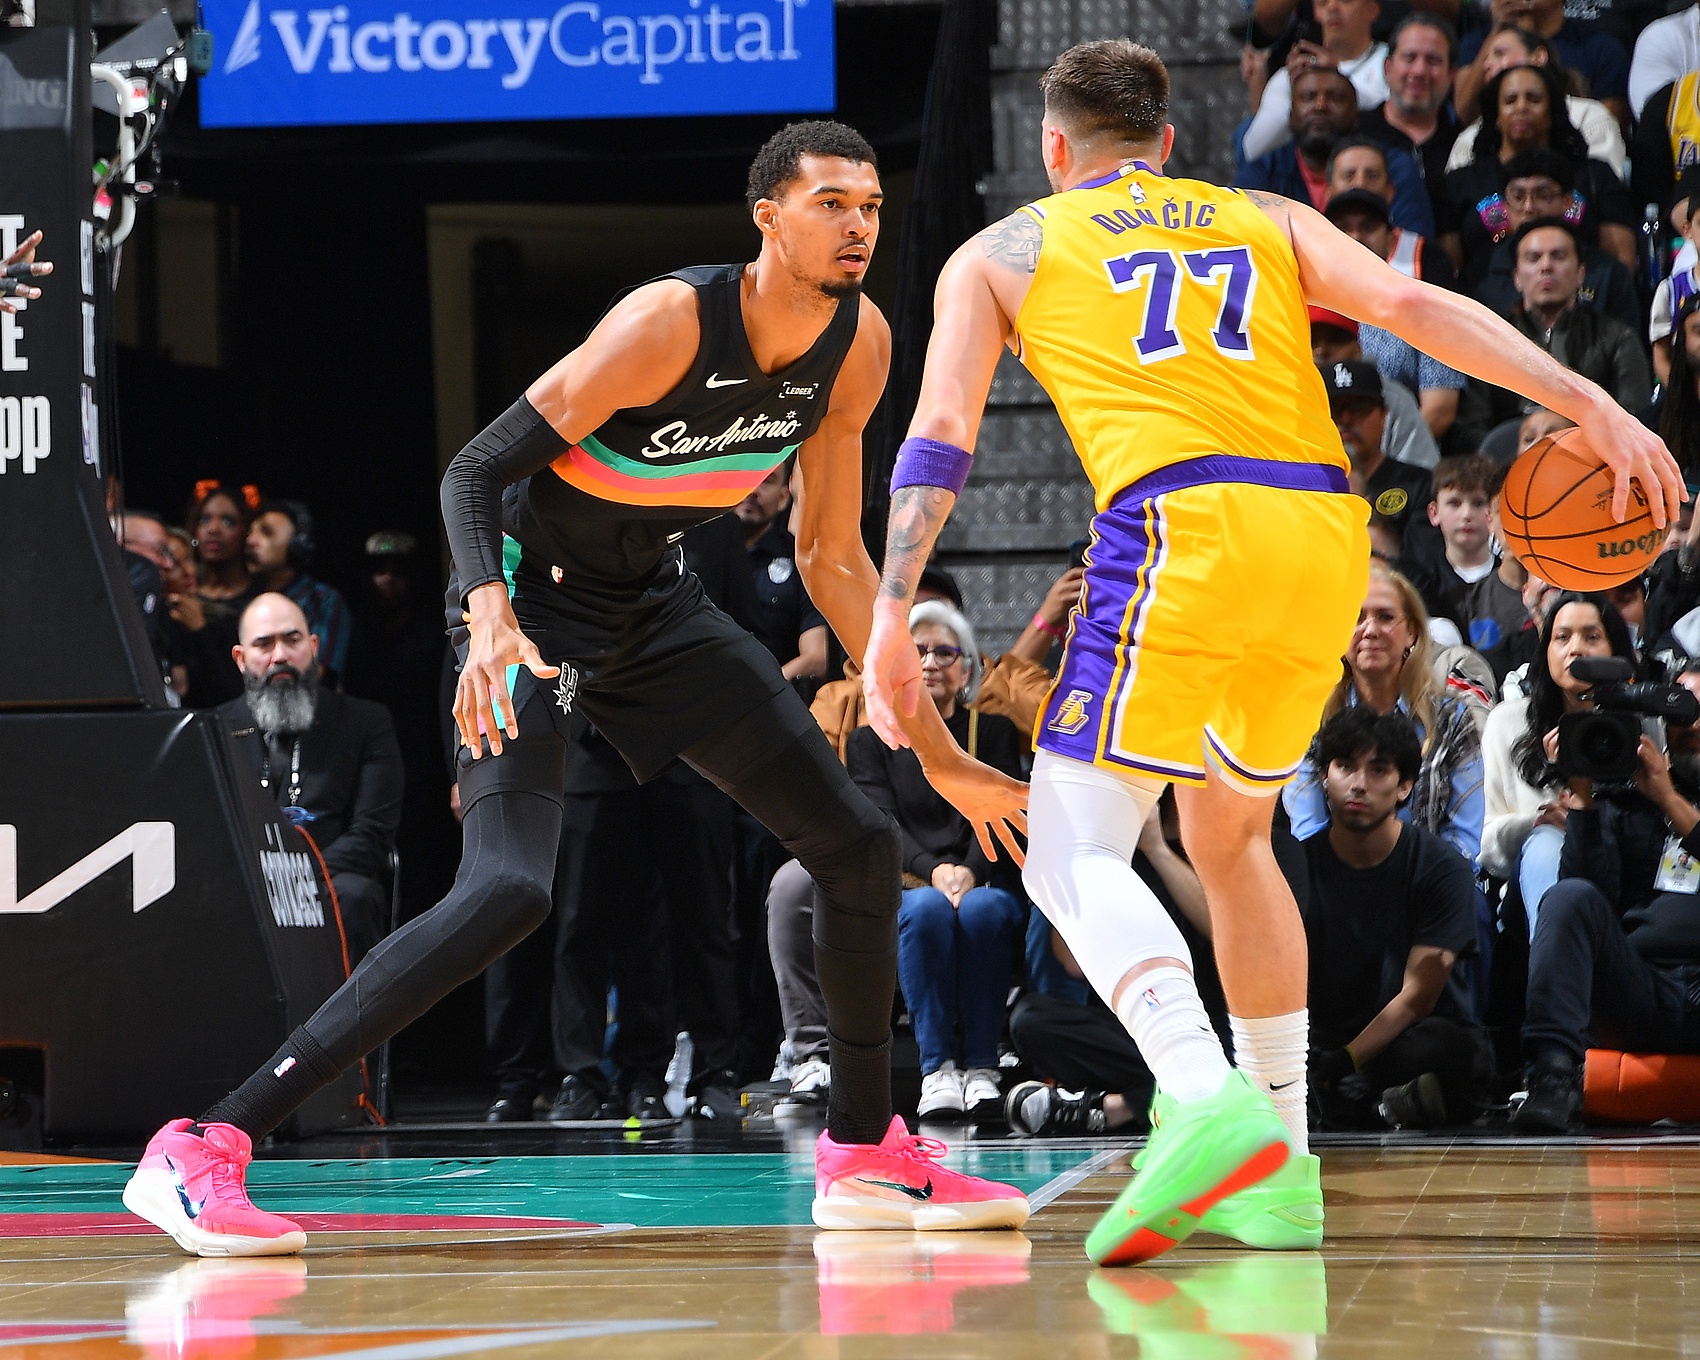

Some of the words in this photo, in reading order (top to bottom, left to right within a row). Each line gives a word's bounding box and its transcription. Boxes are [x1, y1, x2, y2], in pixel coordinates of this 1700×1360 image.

[1102, 244, 1259, 366] 77
[784, 386, 814, 396] LEDGER
[1333, 362, 1353, 389] LA
[641, 420, 709, 459] San
[704, 410, 802, 452] Antonio
[1597, 519, 1671, 559] ilson
